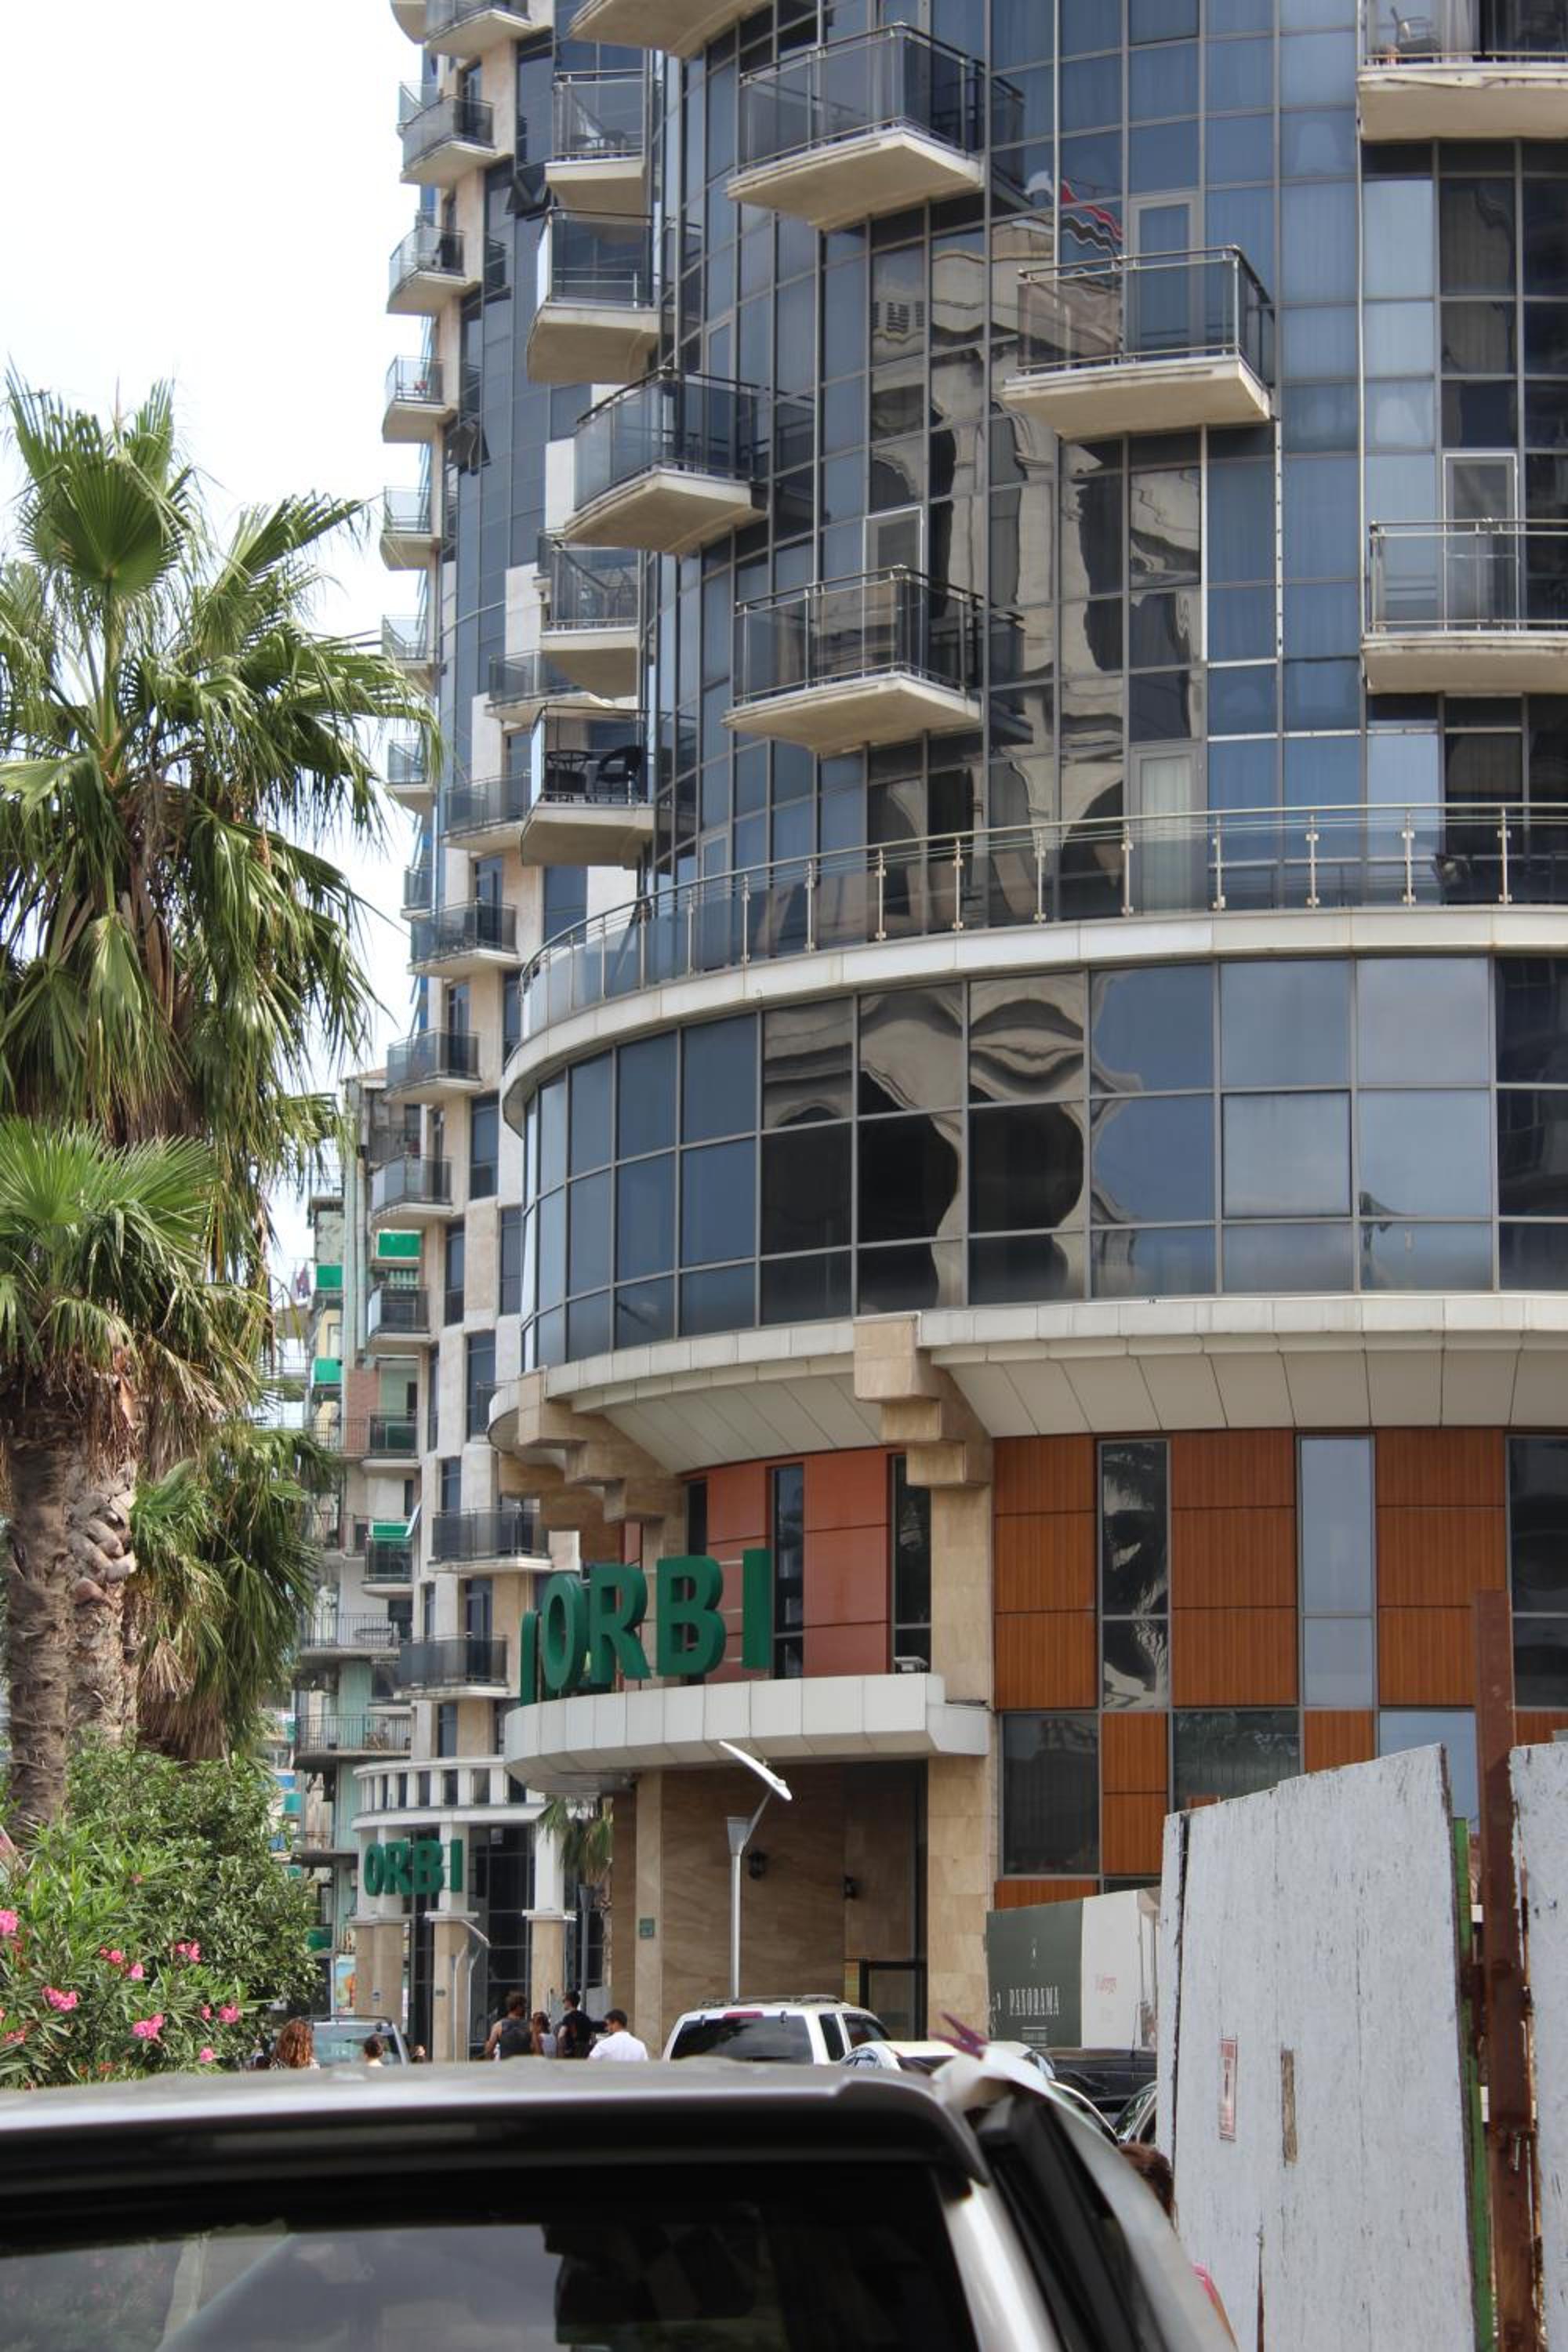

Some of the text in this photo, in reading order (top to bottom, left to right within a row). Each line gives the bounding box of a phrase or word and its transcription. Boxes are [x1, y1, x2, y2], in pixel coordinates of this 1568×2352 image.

[541, 1548, 773, 1691] ORBI
[364, 1839, 463, 1896] ORBI
[1010, 1986, 1059, 2016] PANORAMA
